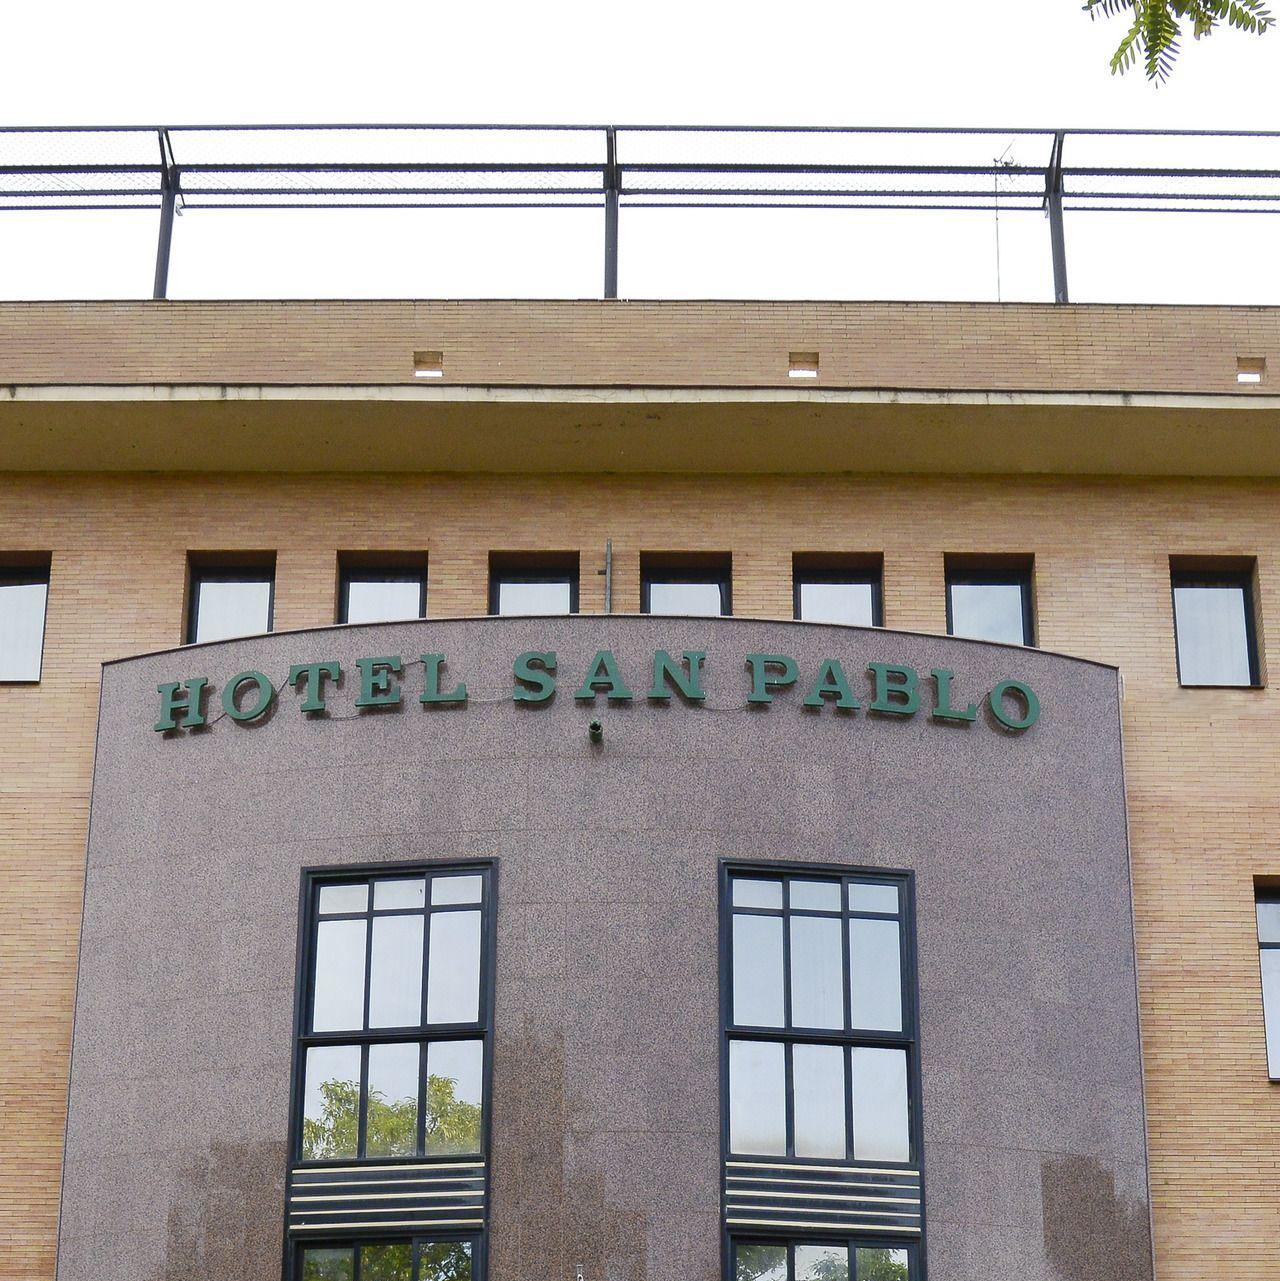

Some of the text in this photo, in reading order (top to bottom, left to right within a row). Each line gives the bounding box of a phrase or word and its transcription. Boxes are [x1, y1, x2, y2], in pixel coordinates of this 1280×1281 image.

[154, 650, 1042, 733] HOTEL SAN PABLO
